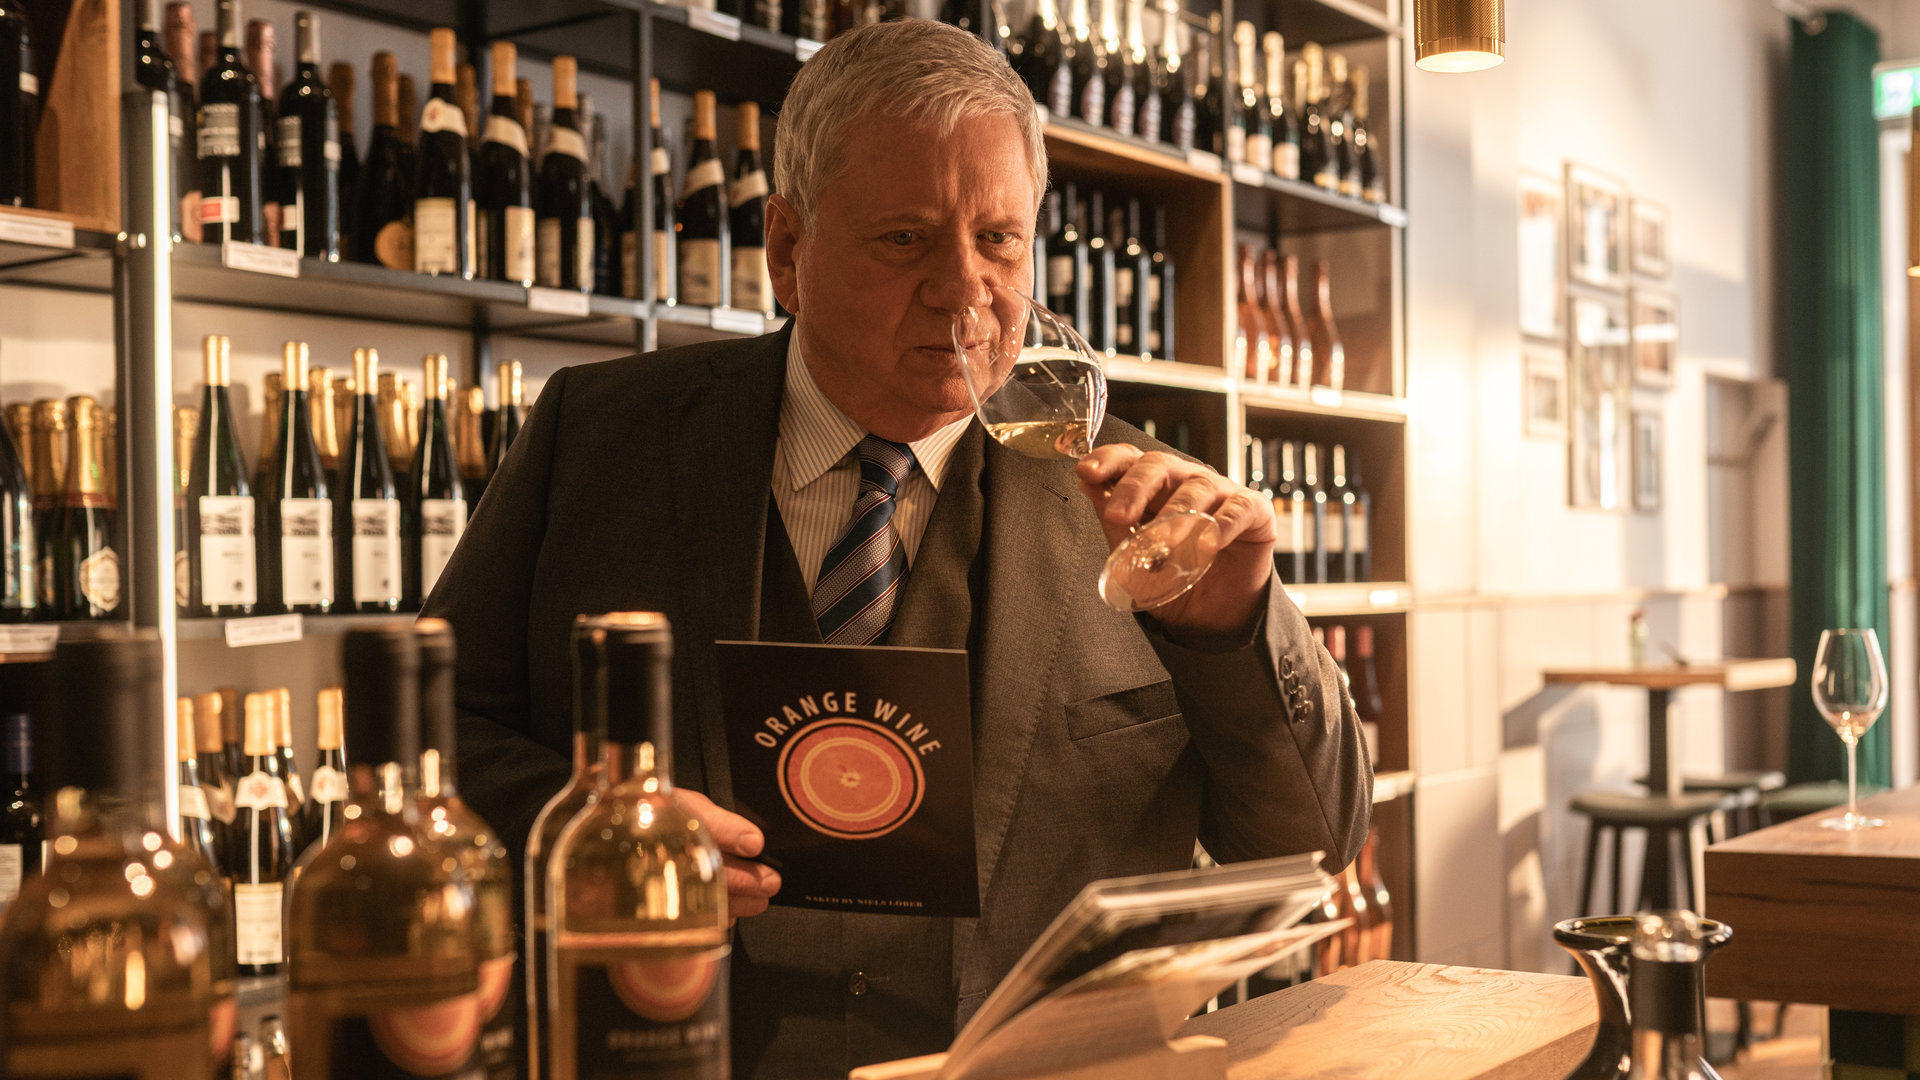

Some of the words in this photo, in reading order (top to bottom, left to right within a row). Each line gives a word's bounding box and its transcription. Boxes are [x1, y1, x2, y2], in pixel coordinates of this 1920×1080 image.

[754, 691, 857, 748] ORANGE
[873, 698, 942, 756] WINE
[805, 895, 840, 903] NAKED
